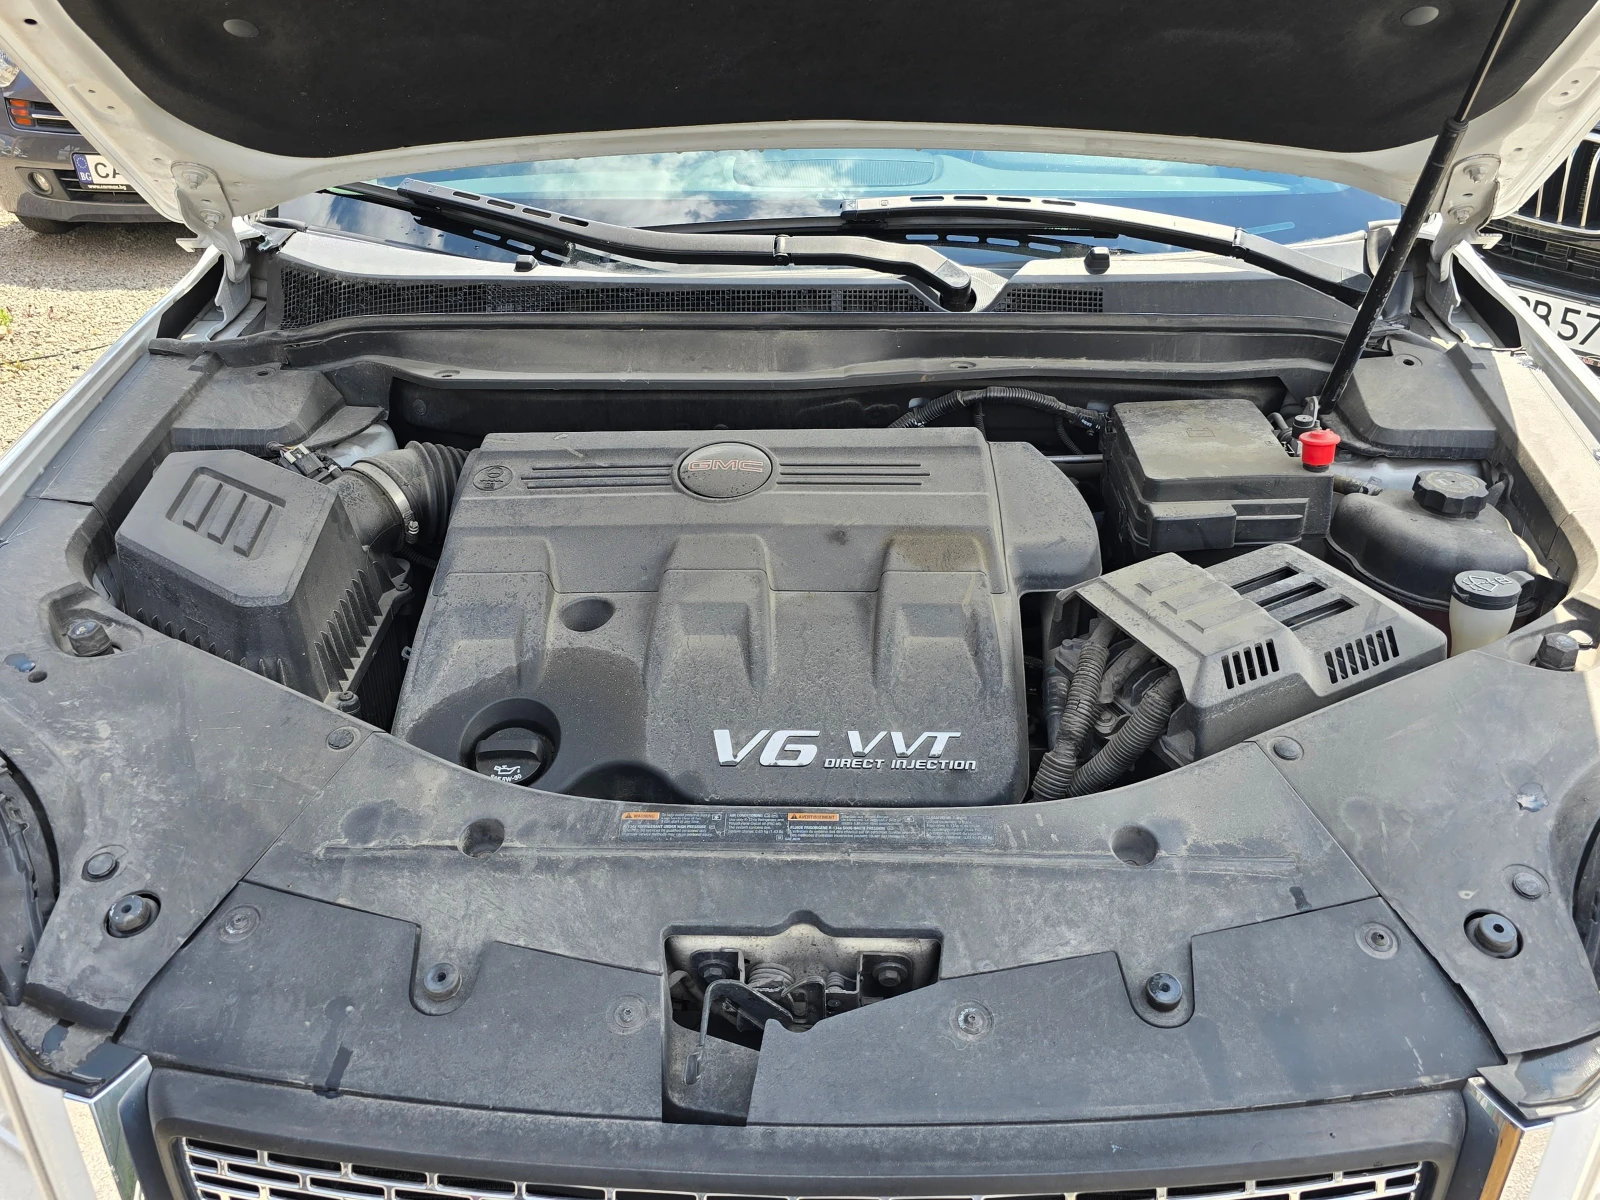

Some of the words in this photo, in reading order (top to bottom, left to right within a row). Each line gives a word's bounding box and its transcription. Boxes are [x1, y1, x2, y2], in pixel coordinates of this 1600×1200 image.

[80, 172, 92, 180] BG
[688, 460, 763, 472] GMC
[713, 729, 820, 767] V6
[847, 730, 962, 758] VVT
[823, 757, 885, 769] DIRECT
[890, 759, 977, 770] INJECTION
